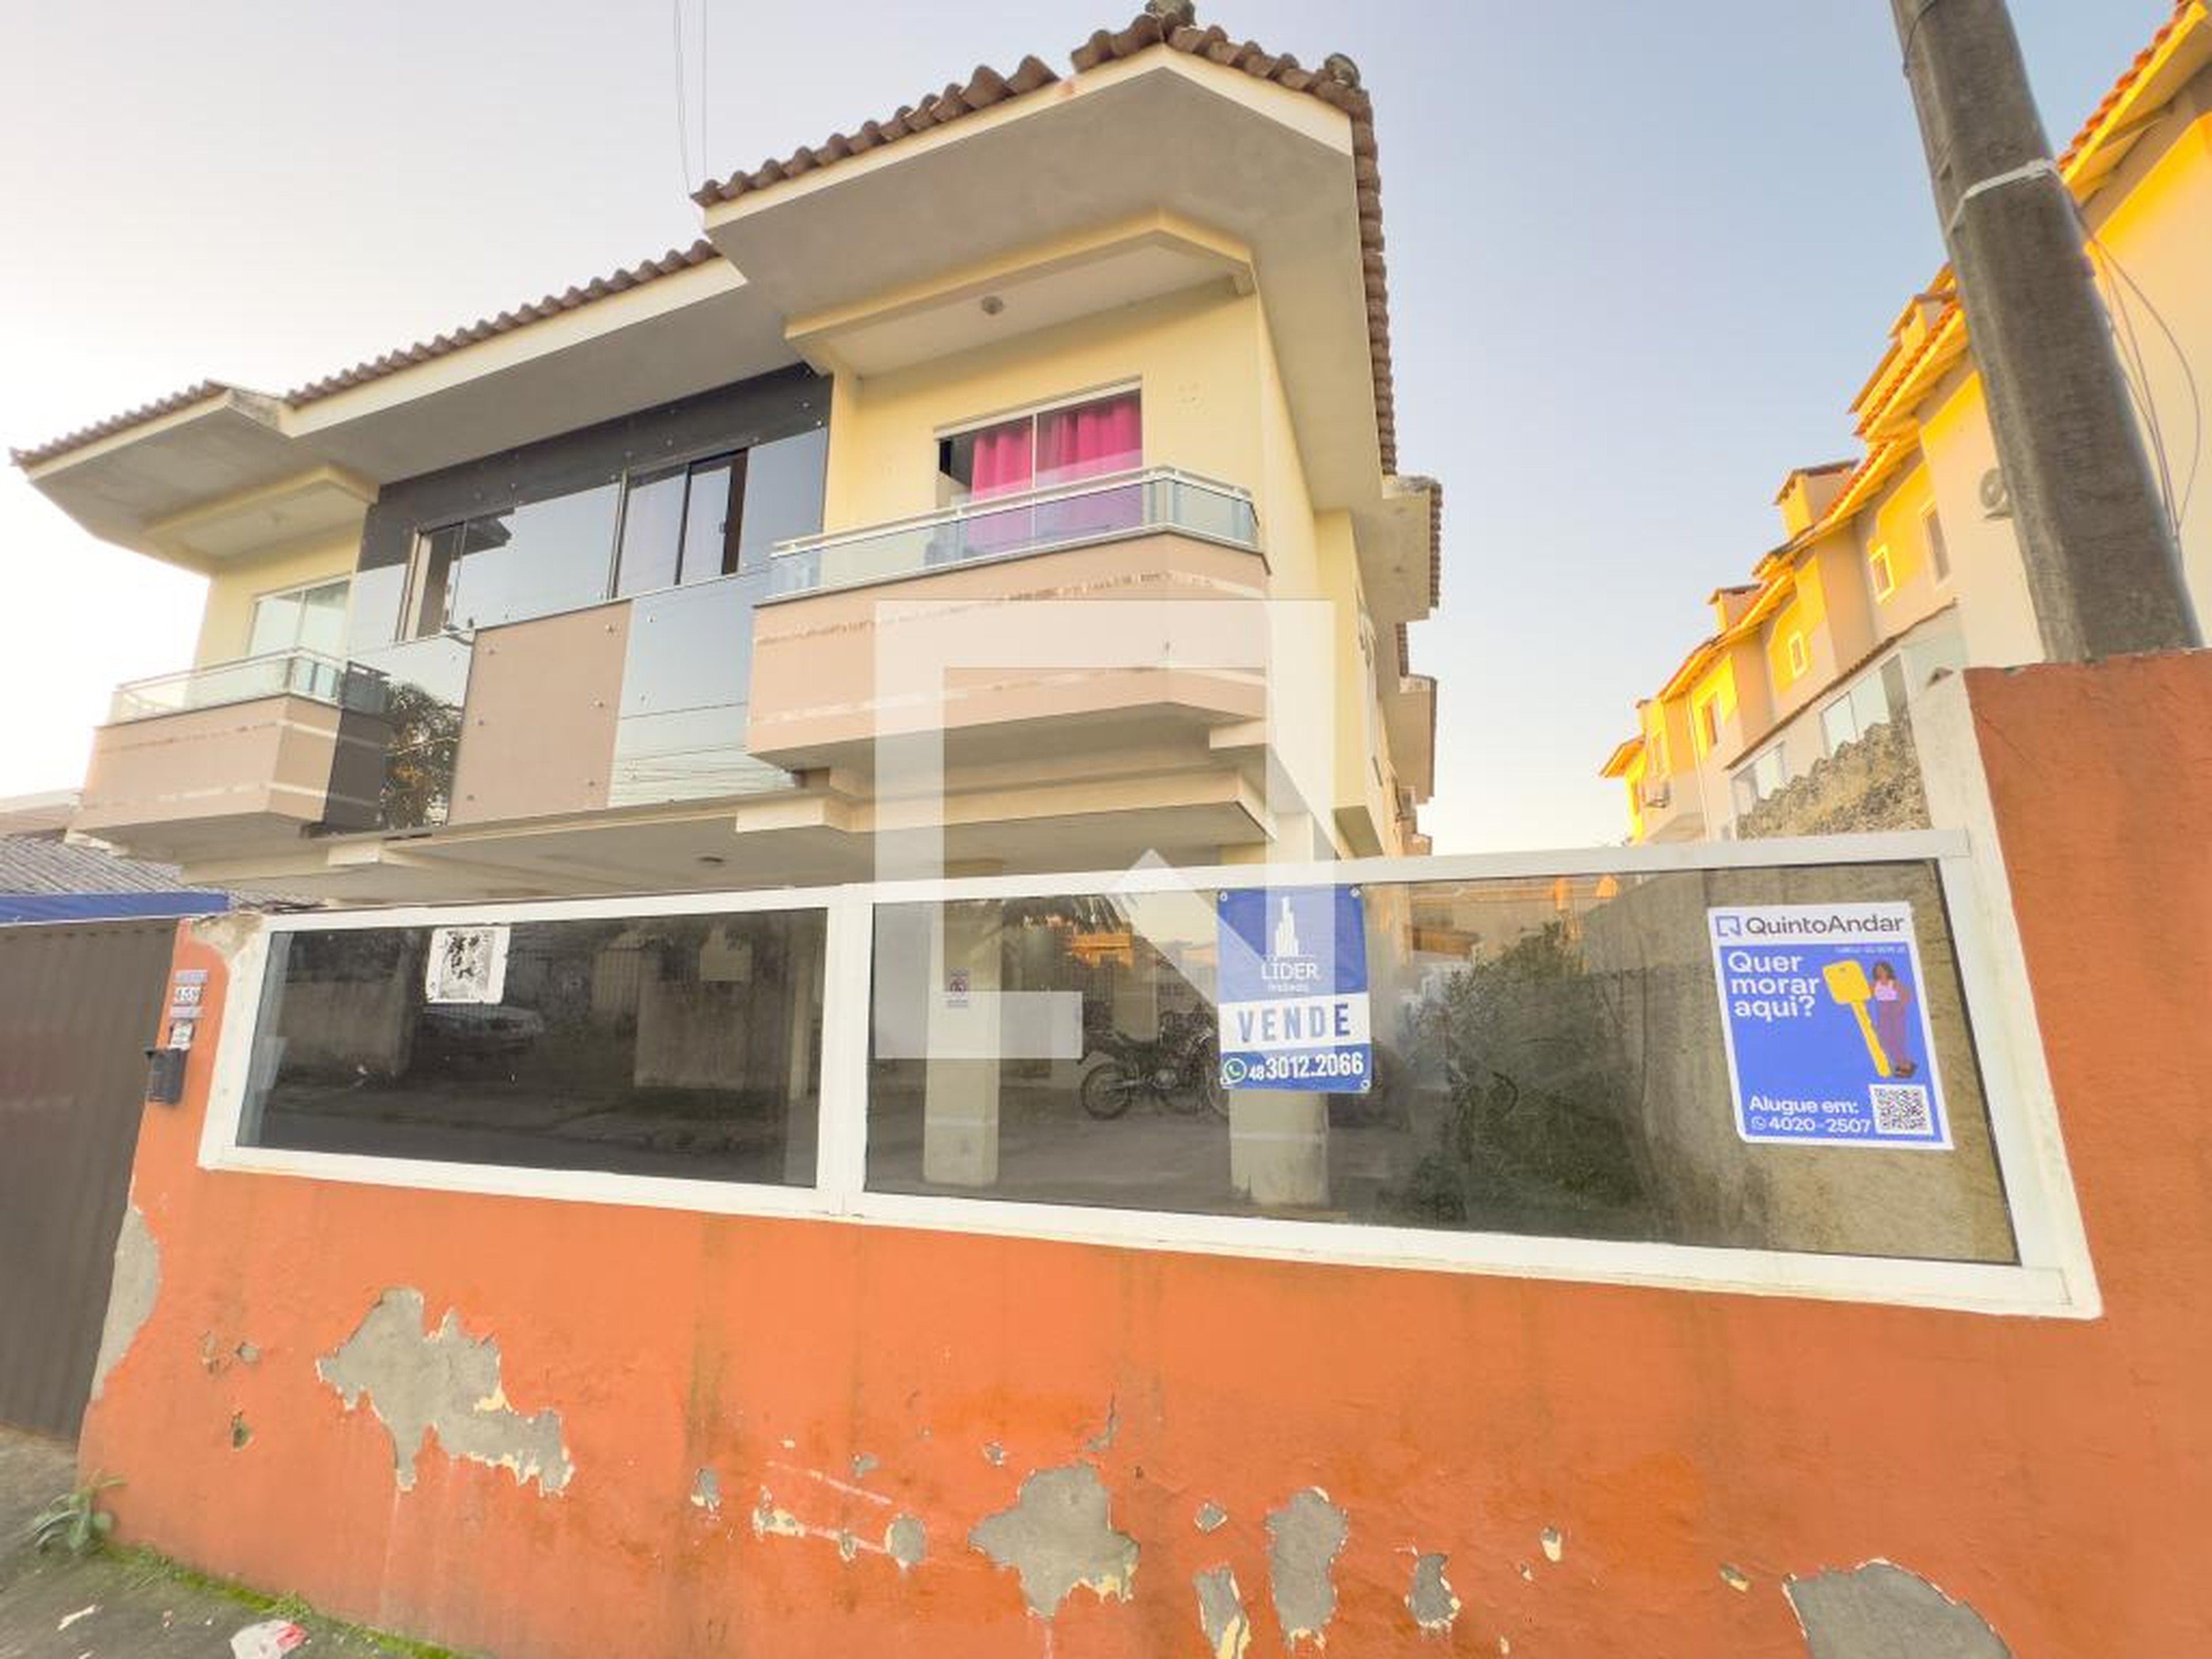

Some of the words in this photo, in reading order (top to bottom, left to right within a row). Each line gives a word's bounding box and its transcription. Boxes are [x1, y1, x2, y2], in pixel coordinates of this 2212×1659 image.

[1746, 915, 1904, 935] QuintoAndar
[1729, 951, 1802, 974] Quer
[1731, 978, 1819, 995] morar
[1734, 995, 1816, 1021] aqui?
[1237, 1003, 1350, 1043] VENDE
[1265, 1052, 1363, 1080] 3012.2066
[1749, 1094, 1819, 1116] Alugue
[1821, 1101, 1860, 1115] em:
